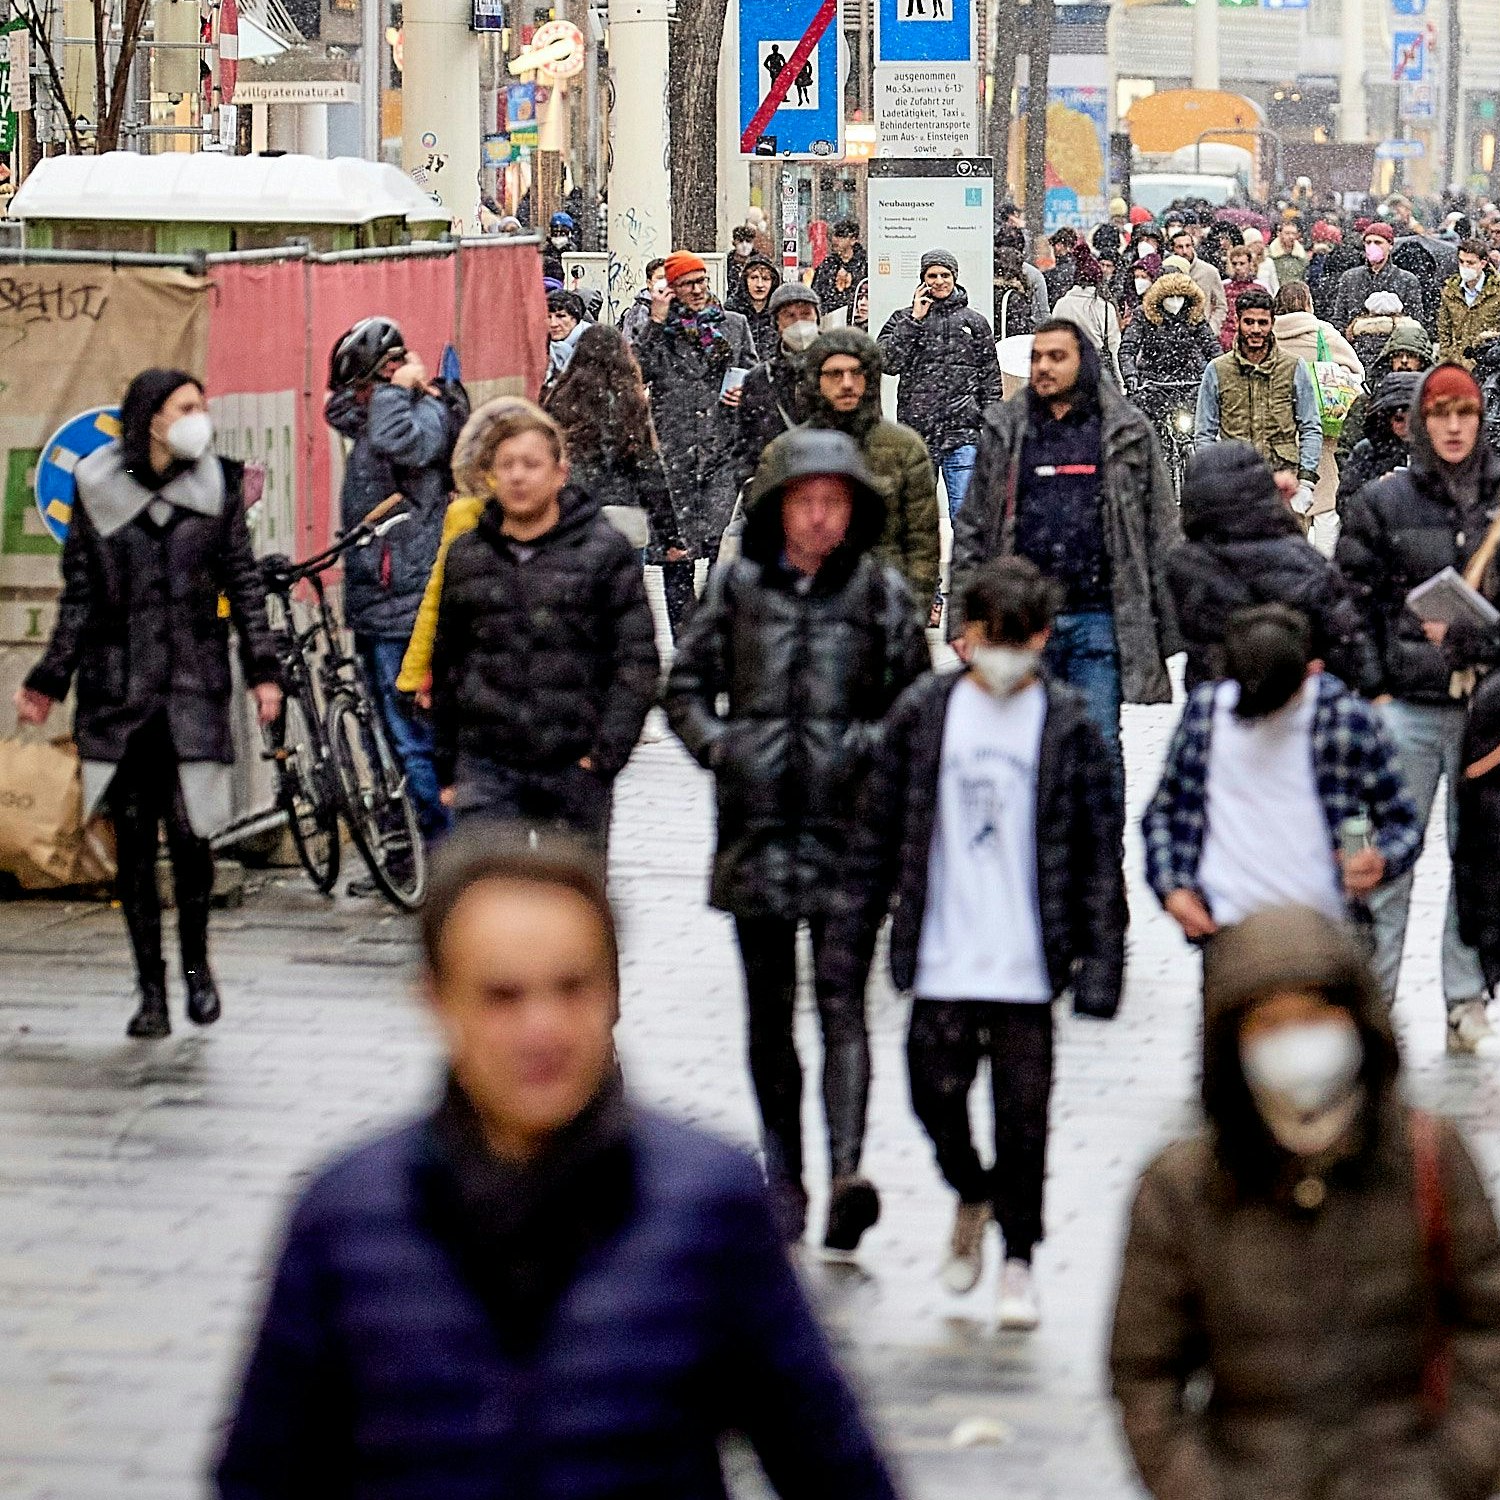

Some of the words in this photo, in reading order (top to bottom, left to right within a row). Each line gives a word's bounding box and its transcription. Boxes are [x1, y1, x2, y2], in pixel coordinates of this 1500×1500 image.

[894, 72, 956, 82] ausgenommen
[895, 97, 908, 106] die
[910, 97, 940, 106] Zufahrt
[942, 98, 955, 106] zur
[882, 109, 938, 118] Ladetätigkeit,
[943, 108, 959, 117] Taxi
[880, 121, 971, 130] Behindertentransporte
[900, 132, 918, 141] Aus-
[927, 132, 969, 142] Einsteigen
[914, 144, 937, 153] sowie
[878, 200, 935, 209] Neubaugasse
